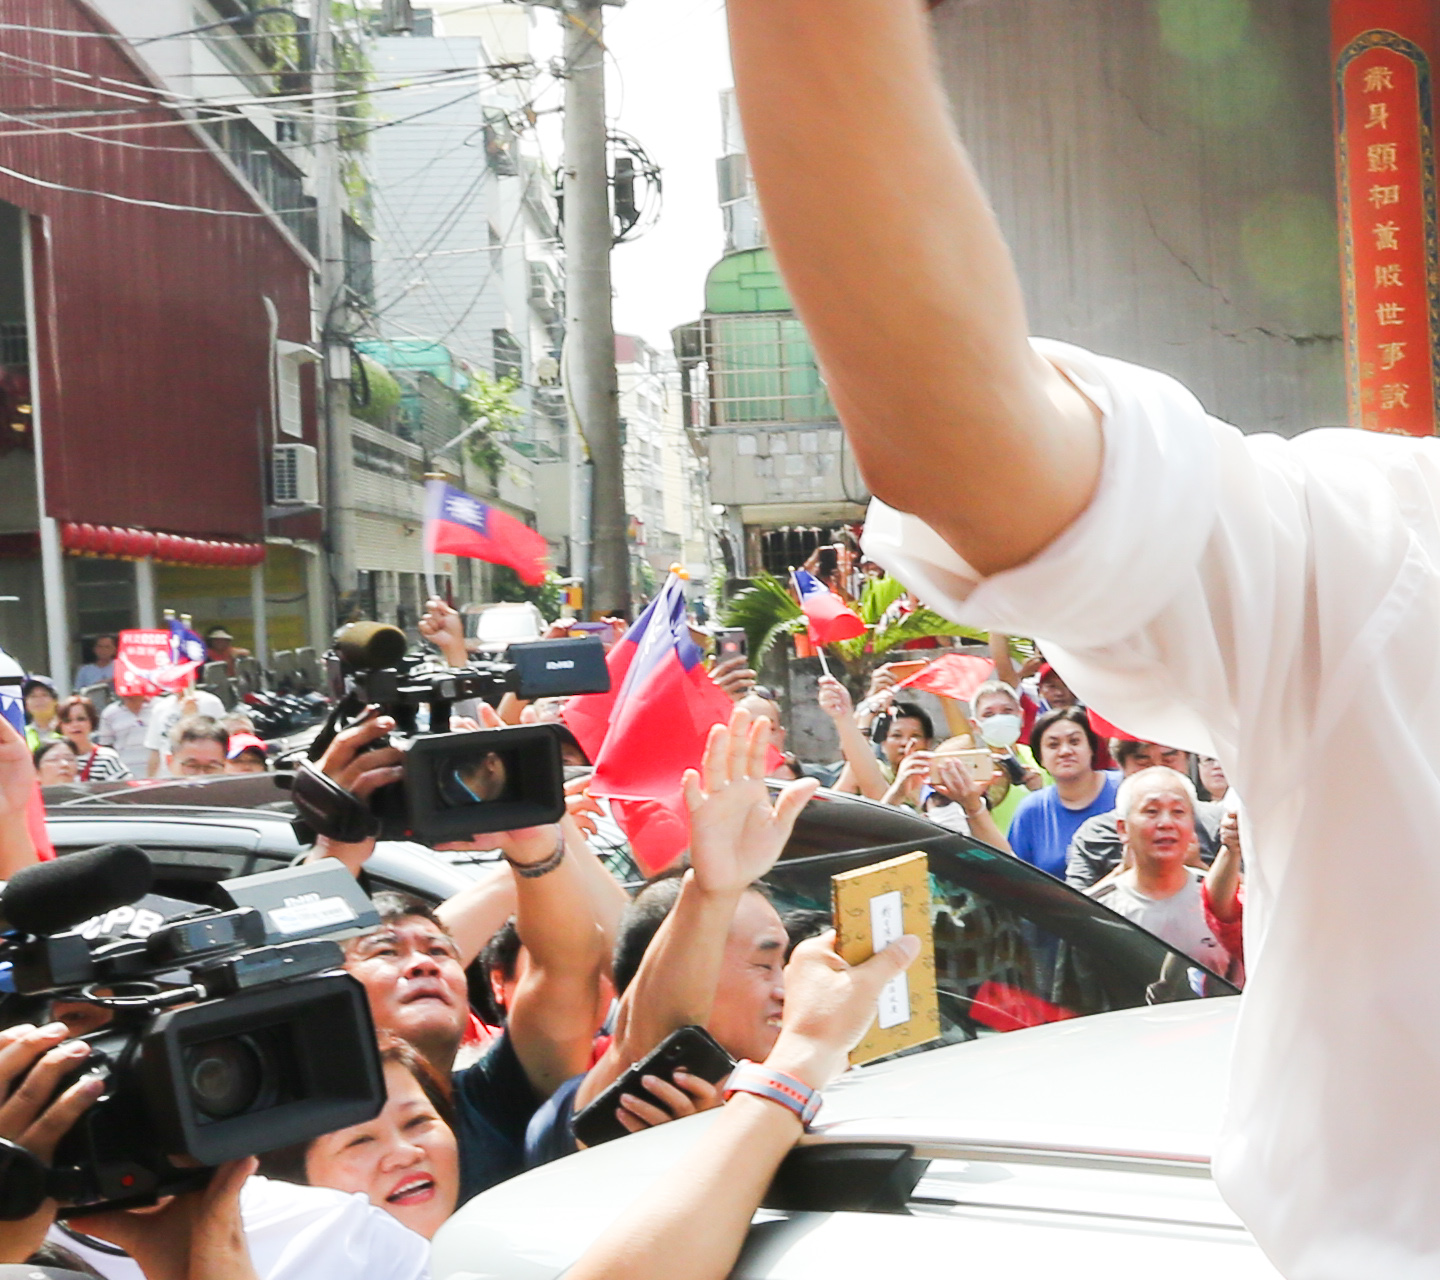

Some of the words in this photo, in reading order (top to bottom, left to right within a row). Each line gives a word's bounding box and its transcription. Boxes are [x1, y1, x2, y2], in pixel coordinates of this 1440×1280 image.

[1361, 66, 1412, 436] 嚴身顯相萬般世事說
